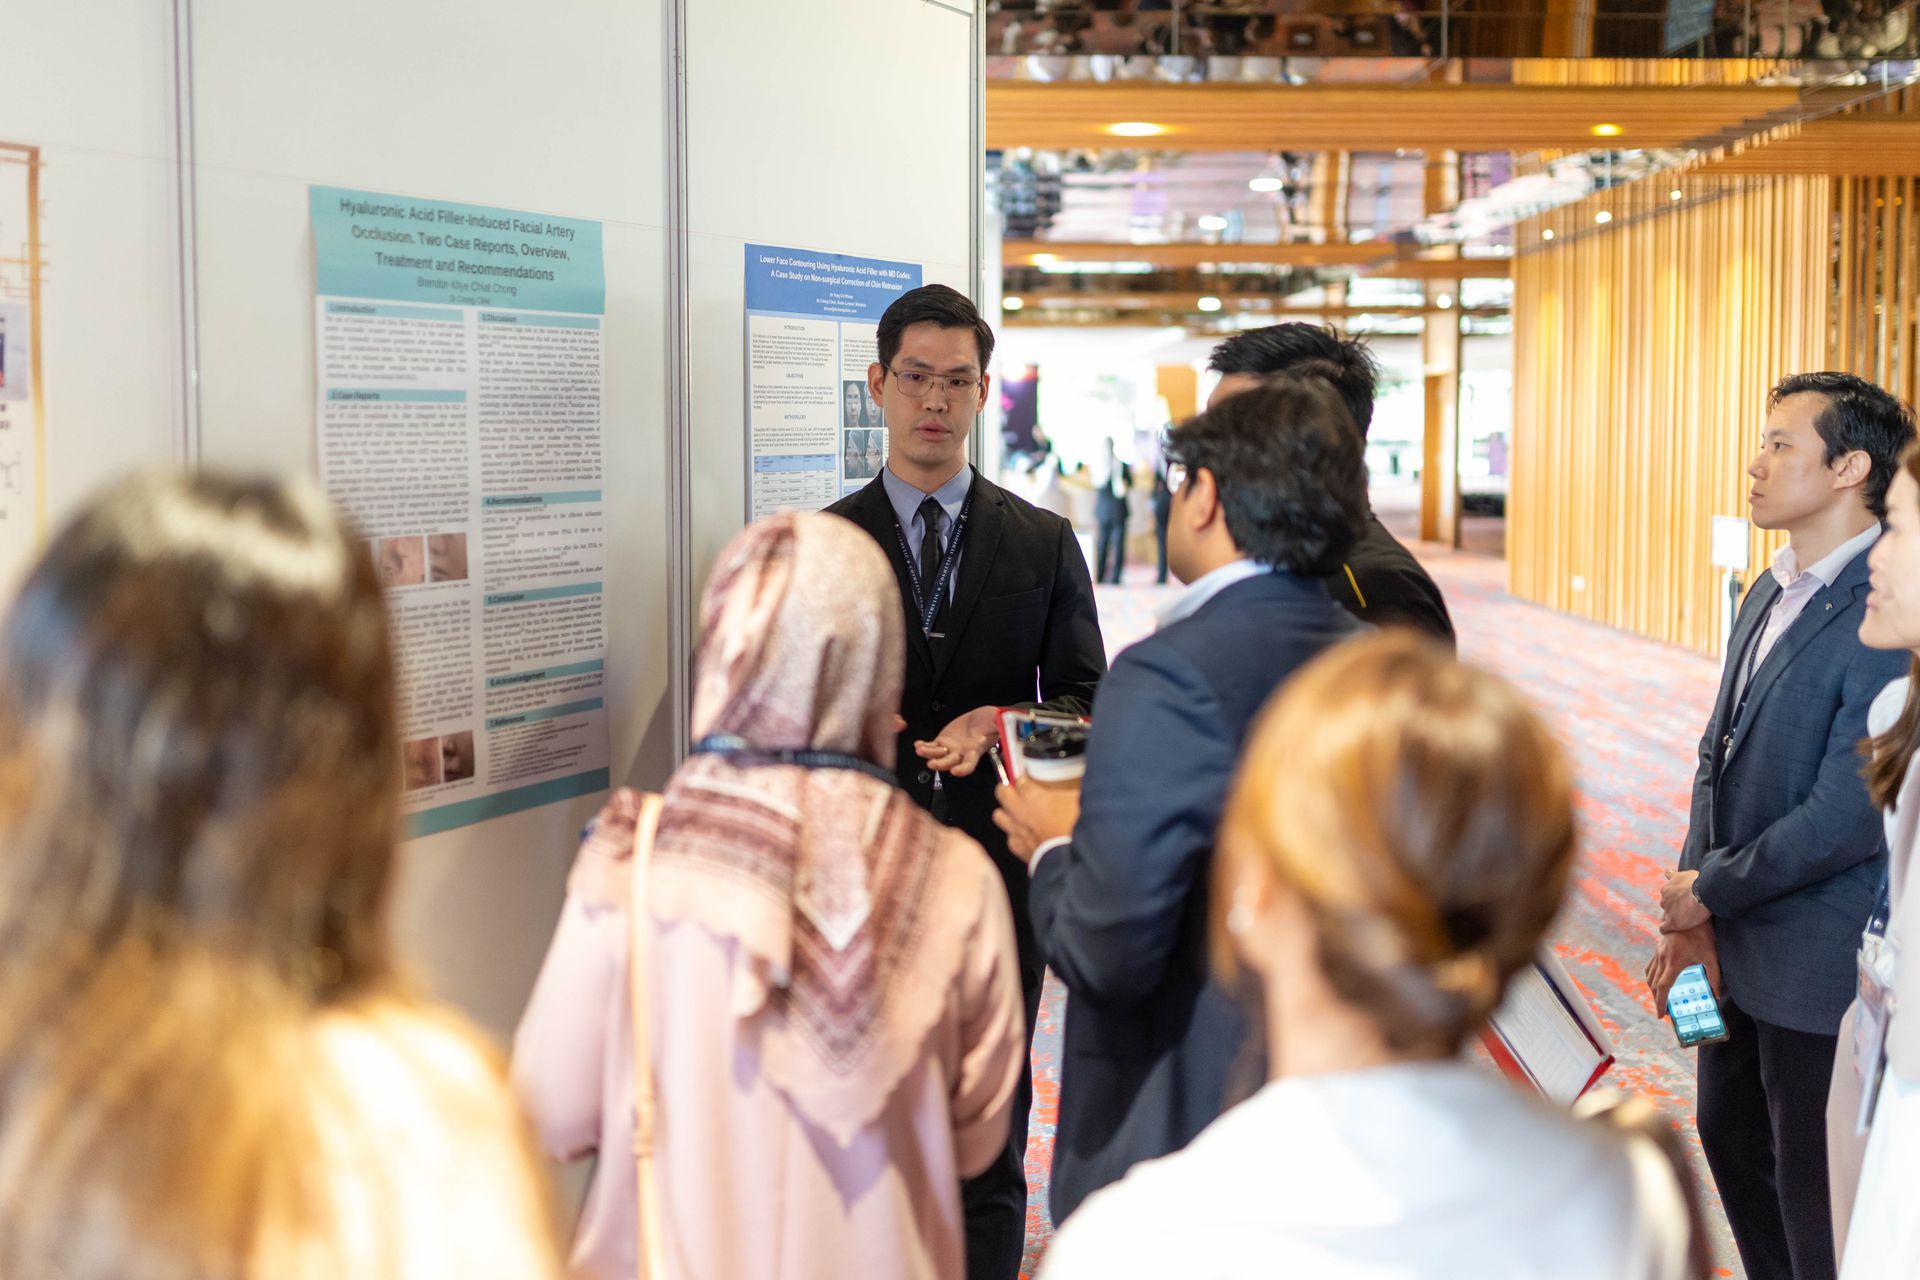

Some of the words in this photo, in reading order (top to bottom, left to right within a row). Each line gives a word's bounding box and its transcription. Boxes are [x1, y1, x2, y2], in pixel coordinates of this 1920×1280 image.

[340, 198, 405, 218] Hyaluronic
[409, 207, 434, 222] Acid
[437, 210, 510, 231] Filler-Induced
[513, 219, 543, 235] Facial
[545, 224, 575, 241] Artery
[351, 225, 415, 244] Occlusion.
[418, 232, 442, 247] Two
[444, 234, 471, 250] Case
[473, 238, 519, 257] Reports,
[521, 243, 570, 261] Overview,
[375, 252, 433, 270] Treatment
[435, 259, 455, 272] and
[457, 260, 555, 281] Recommendations
[760, 254, 776, 264] Lower
[776, 256, 789, 266] Face
[789, 258, 816, 270] Contouring
[816, 261, 831, 272] Using
[831, 263, 856, 273] Hyaluronic
[856, 266, 867, 274] Acid
[867, 267, 878, 276] Filler
[770, 269, 776, 278] A
[775, 270, 789, 279] Case
[788, 271, 803, 282] Study
[811, 273, 840, 286] Non-surgical
[841, 277, 865, 287] Correction
[871, 280, 881, 289] Chin
